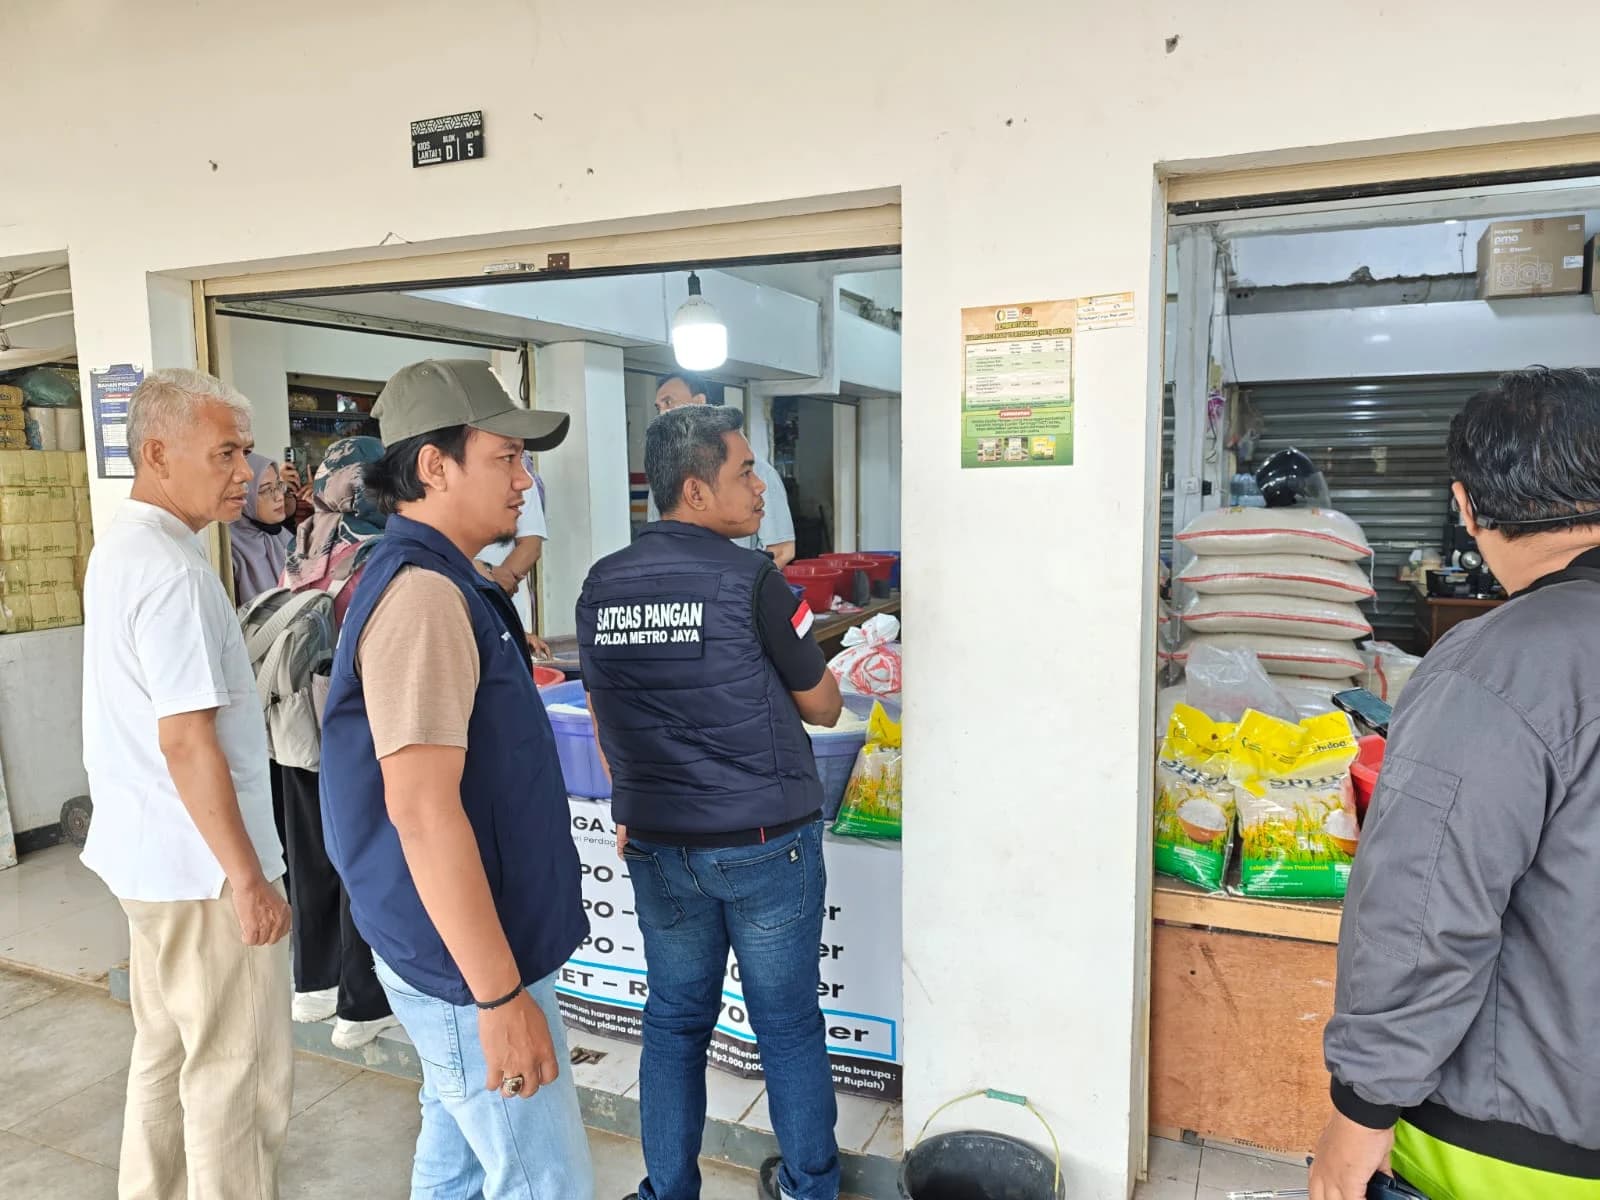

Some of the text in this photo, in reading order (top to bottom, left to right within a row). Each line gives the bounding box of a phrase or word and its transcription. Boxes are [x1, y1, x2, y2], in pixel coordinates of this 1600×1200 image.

[417, 141, 430, 151] KIOS
[442, 133, 455, 143] BLOK
[417, 149, 438, 160] LANTAI
[445, 145, 453, 160] D
[467, 143, 474, 157] 5
[596, 602, 703, 631] SATGAS PANGAN
[594, 629, 700, 645] POLDA METRO JAYA
[573, 816, 605, 832] GA
[583, 836, 616, 848] Perdag
[581, 863, 614, 883] PO
[582, 899, 614, 919] PO
[819, 942, 844, 960] er
[578, 935, 615, 954] PO
[817, 981, 844, 999] er
[557, 967, 594, 988] ET
[828, 1026, 869, 1042] er
[559, 1000, 590, 1015] etentuan
[590, 1009, 616, 1021] harga
[617, 1014, 642, 1026] penju
[710, 1040, 728, 1051] apat
[831, 1063, 852, 1073] nda
[853, 1066, 891, 1080] berupa
[559, 1009, 578, 1021] ahun
[578, 1016, 596, 1026] atau
[597, 1021, 626, 1034] pidana
[831, 1075, 842, 1083] ar
[843, 1076, 885, 1091] Rupiah)
